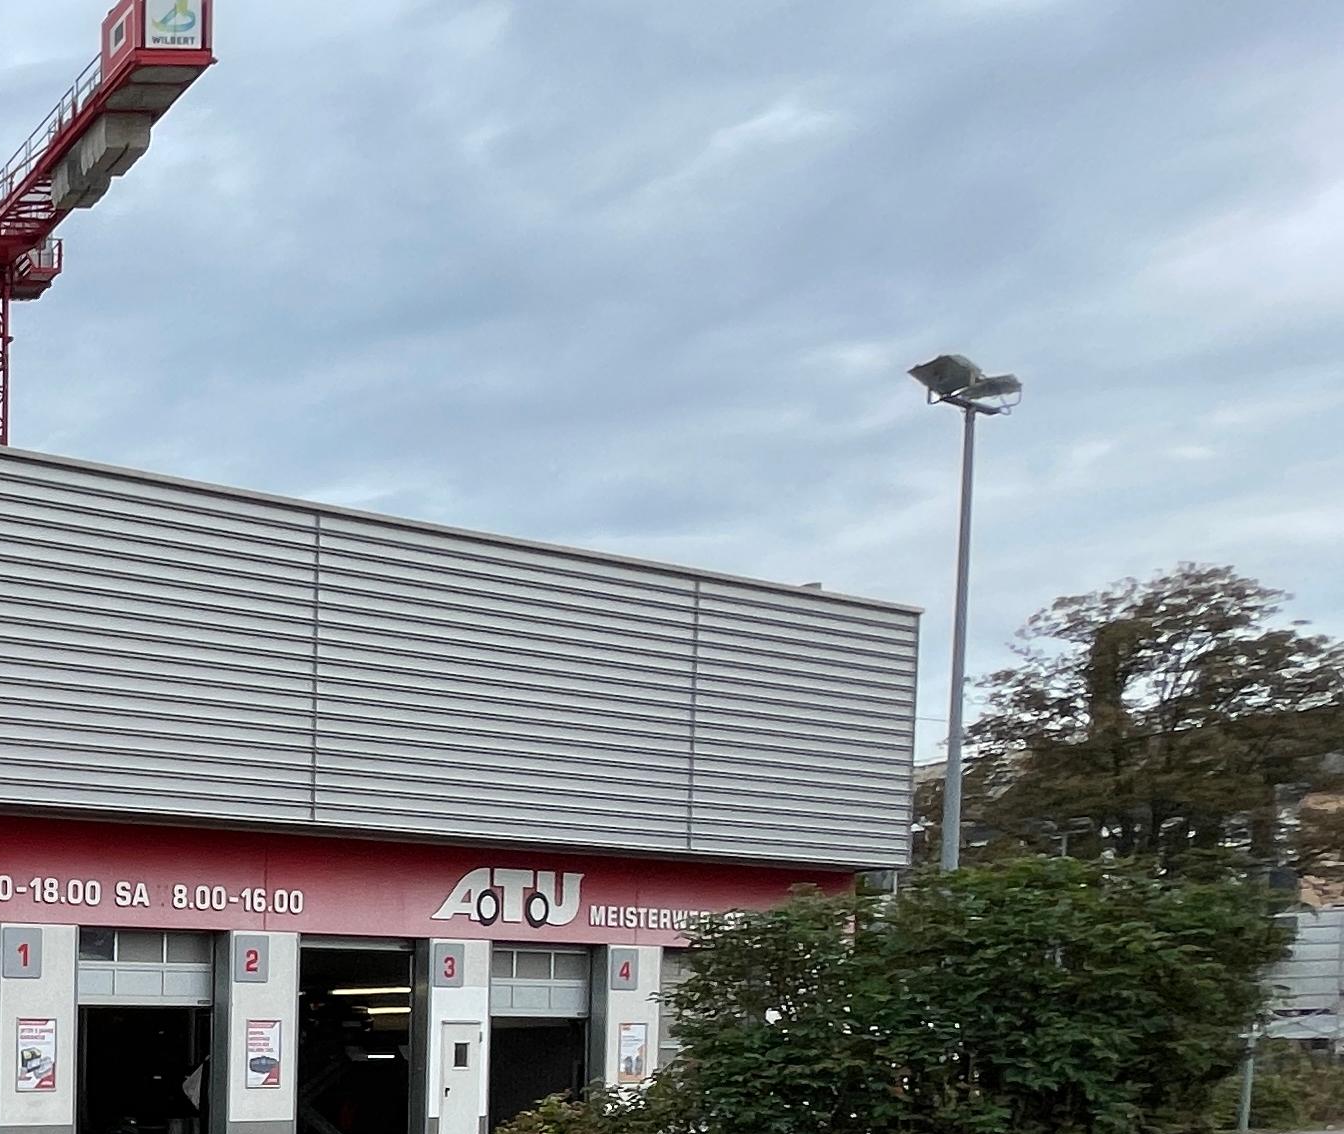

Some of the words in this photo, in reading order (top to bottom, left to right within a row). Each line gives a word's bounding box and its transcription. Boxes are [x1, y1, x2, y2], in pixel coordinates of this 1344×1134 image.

[115, 881, 151, 907] SA
[172, 884, 305, 914] 8.00-16.00
[430, 867, 585, 928] ATU
[17, 943, 29, 967] 1
[245, 949, 259, 973] 2
[444, 956, 456, 979] 3
[619, 960, 631, 981] 4
